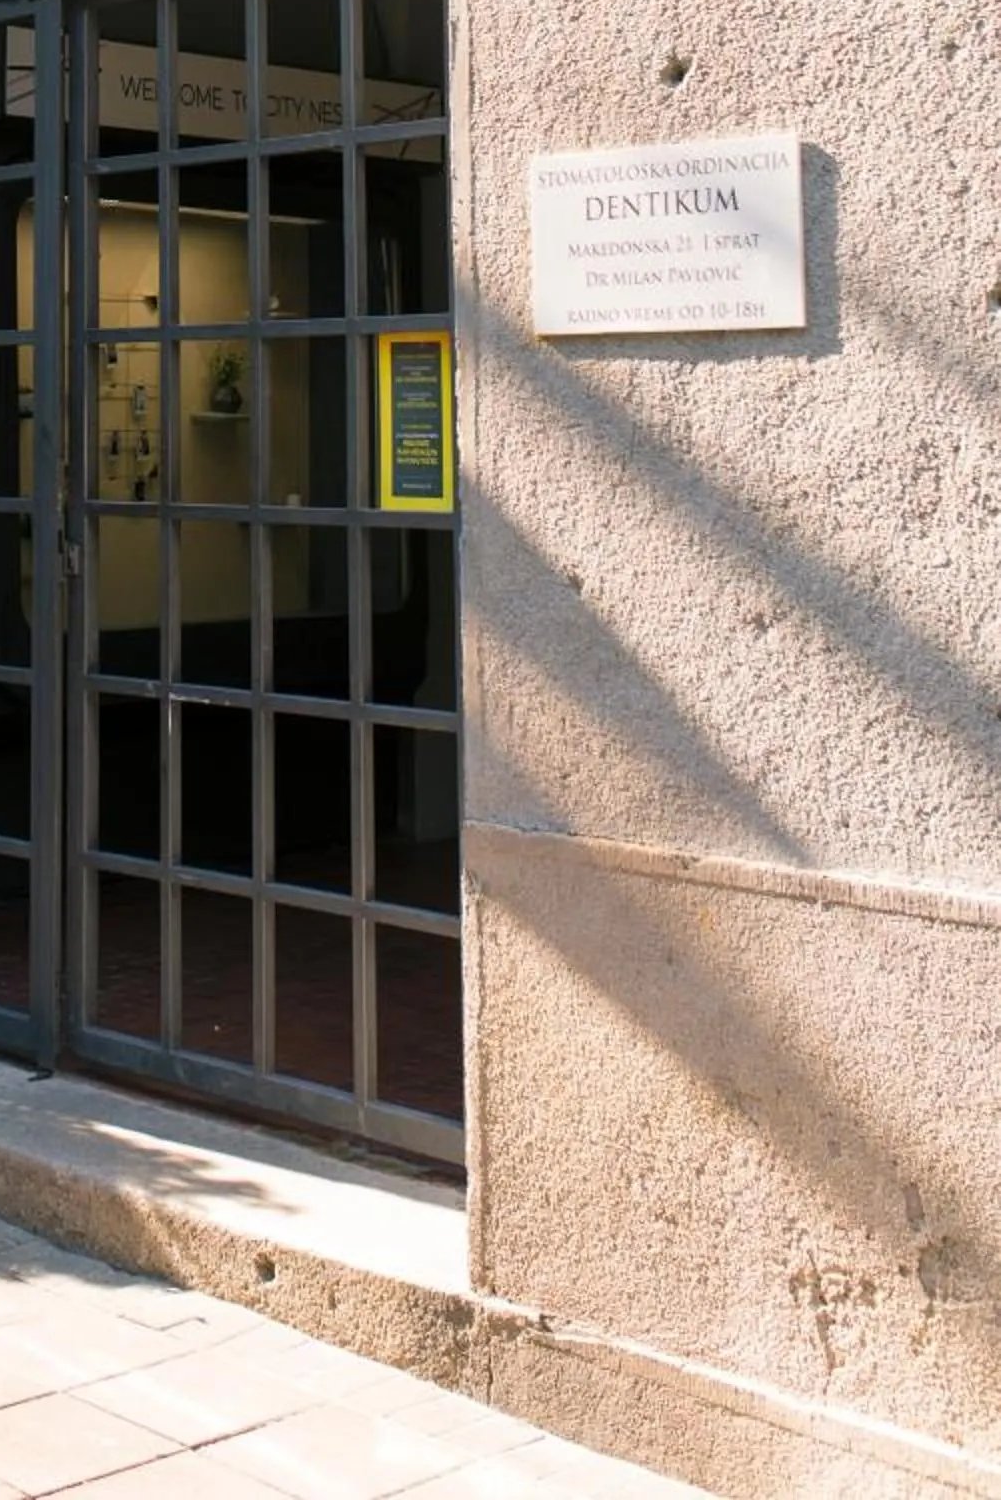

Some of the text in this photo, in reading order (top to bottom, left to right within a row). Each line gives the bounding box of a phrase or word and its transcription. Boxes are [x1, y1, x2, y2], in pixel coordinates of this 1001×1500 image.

[120, 74, 225, 111] WEOME
[309, 100, 344, 125] NES
[675, 151, 791, 178] ORDINACIJA
[585, 185, 741, 222] DENTIKUM
[567, 239, 671, 259] MAKEDONSKA
[714, 232, 760, 250] SPRAT
[613, 269, 663, 288] MILAN
[567, 308, 620, 325] RADNO
[622, 306, 675, 323] VREME
[678, 303, 703, 320] OD
